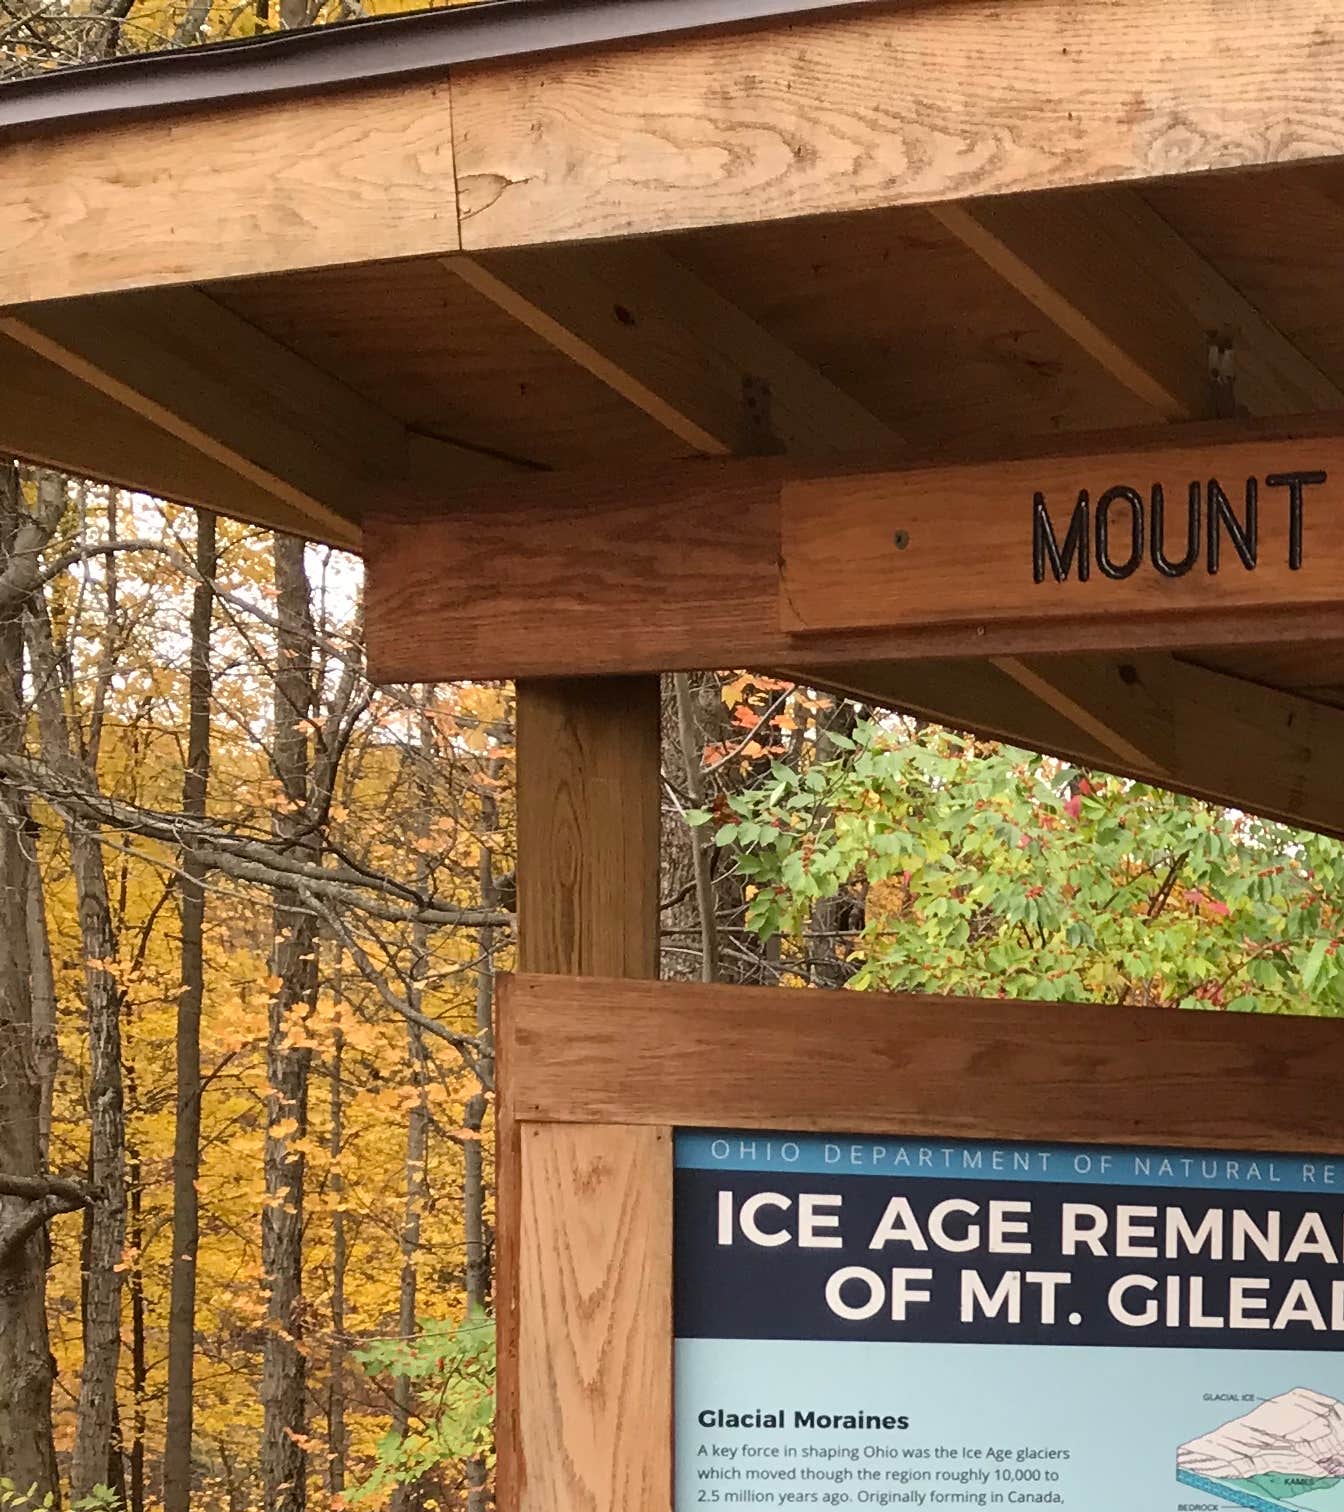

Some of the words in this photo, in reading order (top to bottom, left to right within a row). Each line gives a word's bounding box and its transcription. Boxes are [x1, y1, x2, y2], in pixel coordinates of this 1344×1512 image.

[1032, 470, 1328, 583] MOUNT
[710, 1139, 802, 1162] OHIO
[824, 1145, 1052, 1172] DEPARTMENT
[1074, 1154, 1114, 1176] OF
[1135, 1157, 1281, 1184] NATURAL
[718, 1190, 843, 1249] ICE
[868, 1196, 1032, 1254] AGE
[825, 1265, 933, 1321] OF
[960, 1269, 1081, 1325] MT.
[697, 1408, 785, 1428] Glacial
[794, 1410, 909, 1430] Moraines
[695, 1444, 708, 1457] A
[711, 1443, 738, 1460] key
[741, 1443, 779, 1458] force
[784, 1445, 797, 1457] in
[801, 1444, 860, 1461] shaping
[863, 1445, 899, 1459] Ohio
[901, 1448, 931, 1459] was
[934, 1445, 958, 1459] the
[962, 1447, 983, 1459] Ice
[985, 1446, 1013, 1462] Age
[1015, 1446, 1071, 1463] glaciers
[696, 1466, 741, 1480] which
[745, 1467, 796, 1480] moved
[800, 1467, 853, 1484] though
[856, 1467, 881, 1481] the
[885, 1470, 931, 1484] region
[935, 1467, 991, 1485] roughly
[994, 1468, 1041, 1483] 10,000
[1044, 1469, 1059, 1482] to
